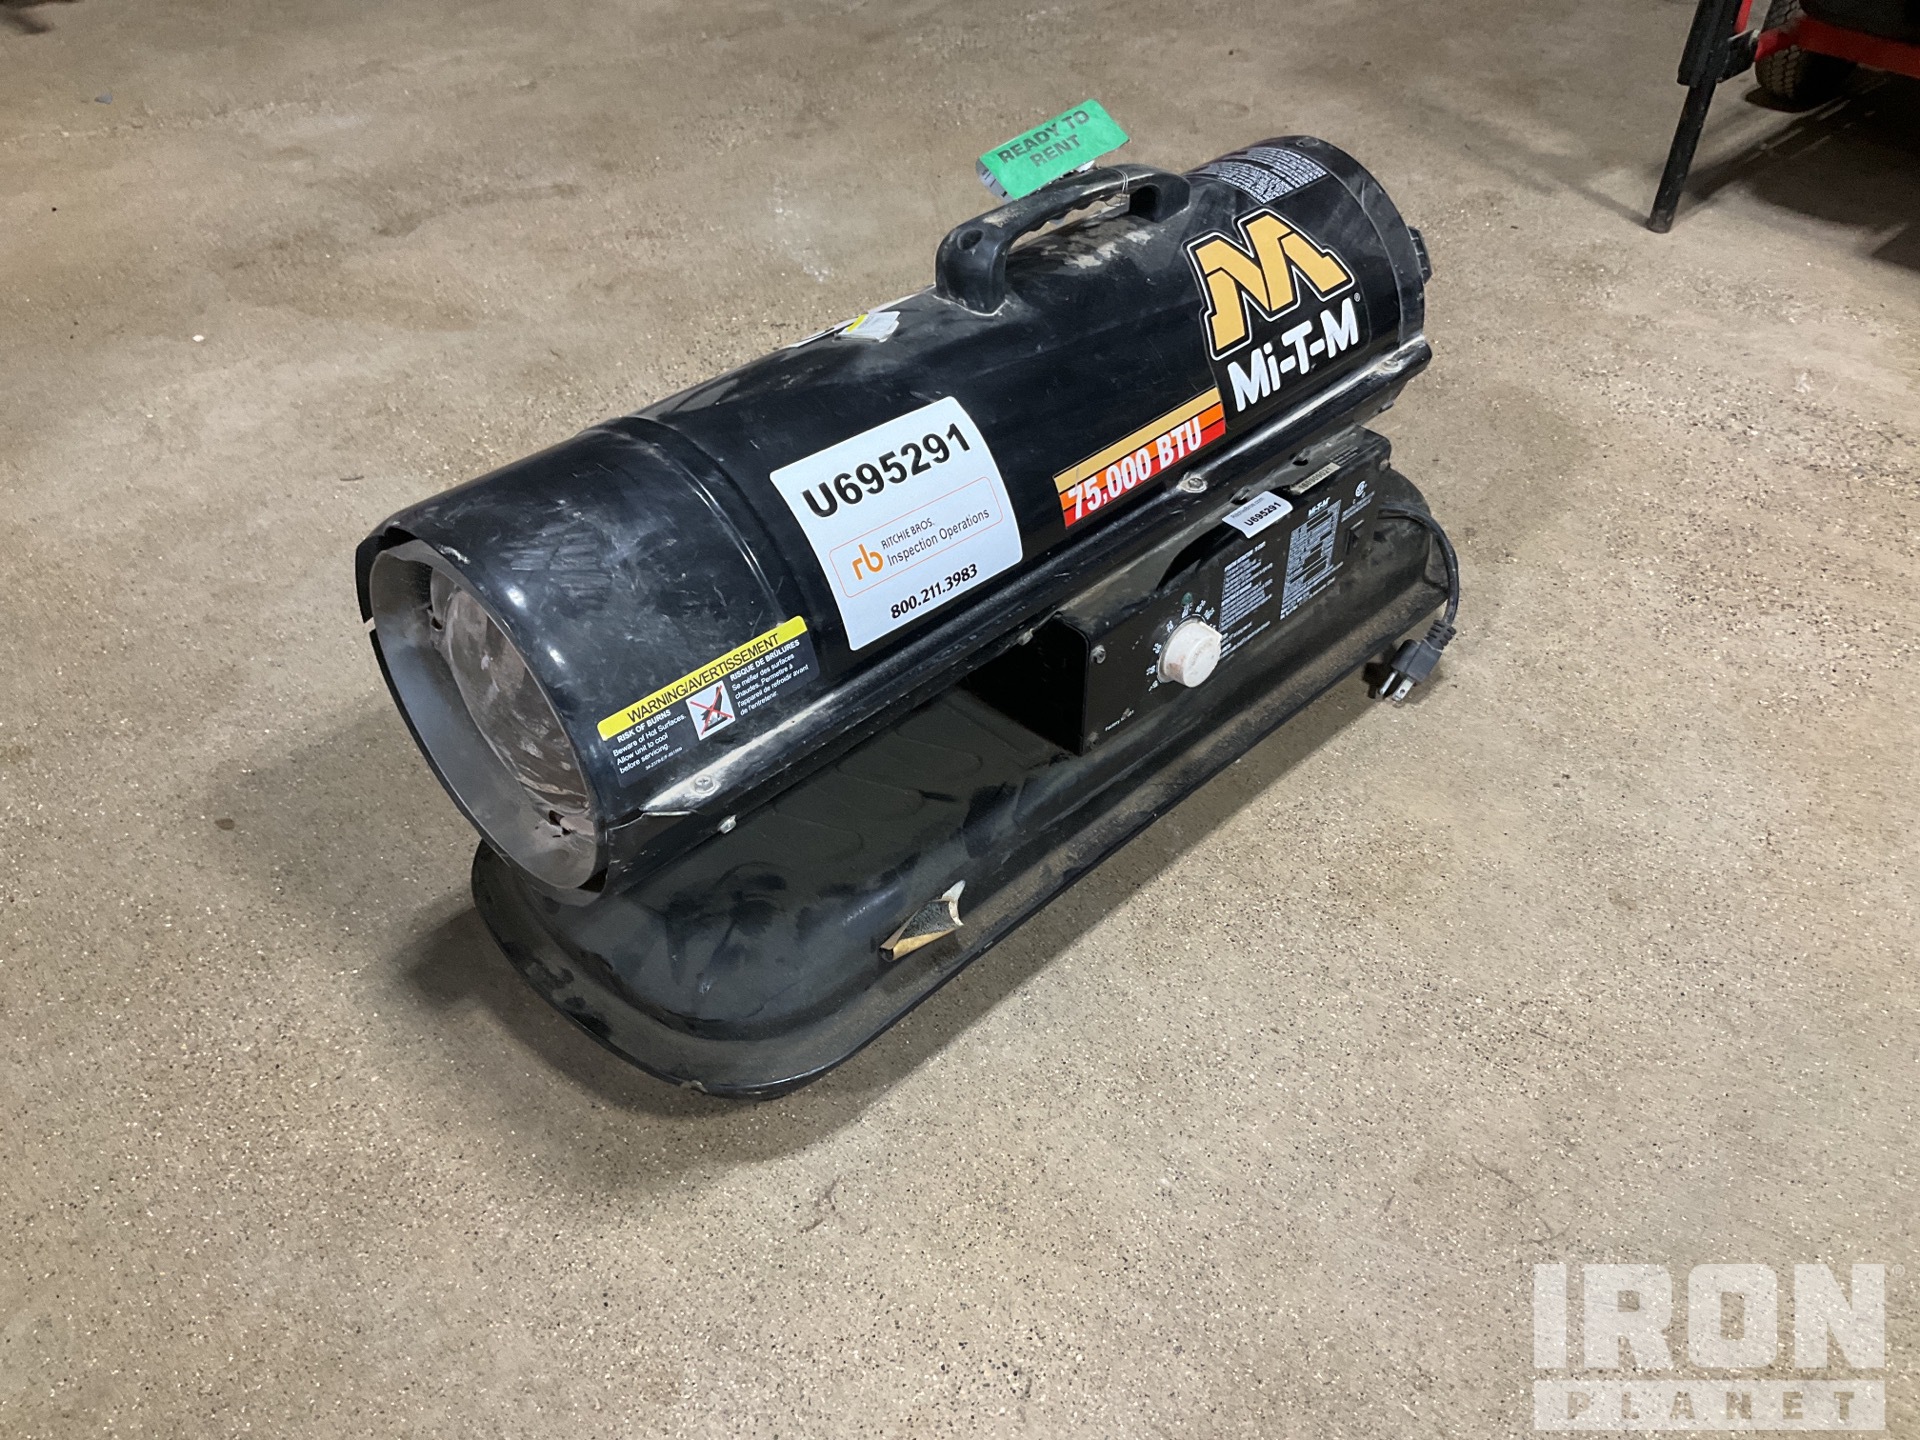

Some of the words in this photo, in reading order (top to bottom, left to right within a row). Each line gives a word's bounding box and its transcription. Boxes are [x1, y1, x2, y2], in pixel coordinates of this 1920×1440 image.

[998, 124, 1060, 164] READY
[1060, 110, 1090, 131] TO
[1029, 134, 1081, 167] RENT
[1227, 298, 1359, 412] Mi-T-M
[802, 423, 971, 518] U695291
[1068, 448, 1151, 520] 75,000
[1156, 416, 1202, 470] BTU
[1244, 502, 1282, 526] U695291
[881, 528, 911, 550] RITCHIE
[911, 517, 935, 538] BROS.
[887, 535, 938, 566] Inspection
[939, 509, 990, 543] Operations
[891, 564, 978, 619] 800.211.3983
[627, 633, 779, 723] WARNING/AVERTISSEMENT
[730, 663, 755, 681] RISQUE
[755, 657, 766, 669] DE
[765, 639, 800, 662] BRÛLURES
[732, 683, 741, 691] Se
[760, 666, 770, 676] des
[771, 653, 795, 670] surfaces
[763, 685, 771, 693] de
[792, 664, 809, 677] avant
[617, 729, 635, 743] RISK
[635, 723, 646, 733] OF
[646, 709, 671, 727] BURNS
[740, 708, 748, 716] de
[612, 740, 638, 757] Beware
[638, 734, 646, 743] of
[645, 728, 658, 740] Hot
[616, 752, 634, 766] Allow
[634, 744, 648, 755] unit
[647, 741, 655, 749] to
[654, 732, 669, 744] cool
[619, 759, 640, 774] before
